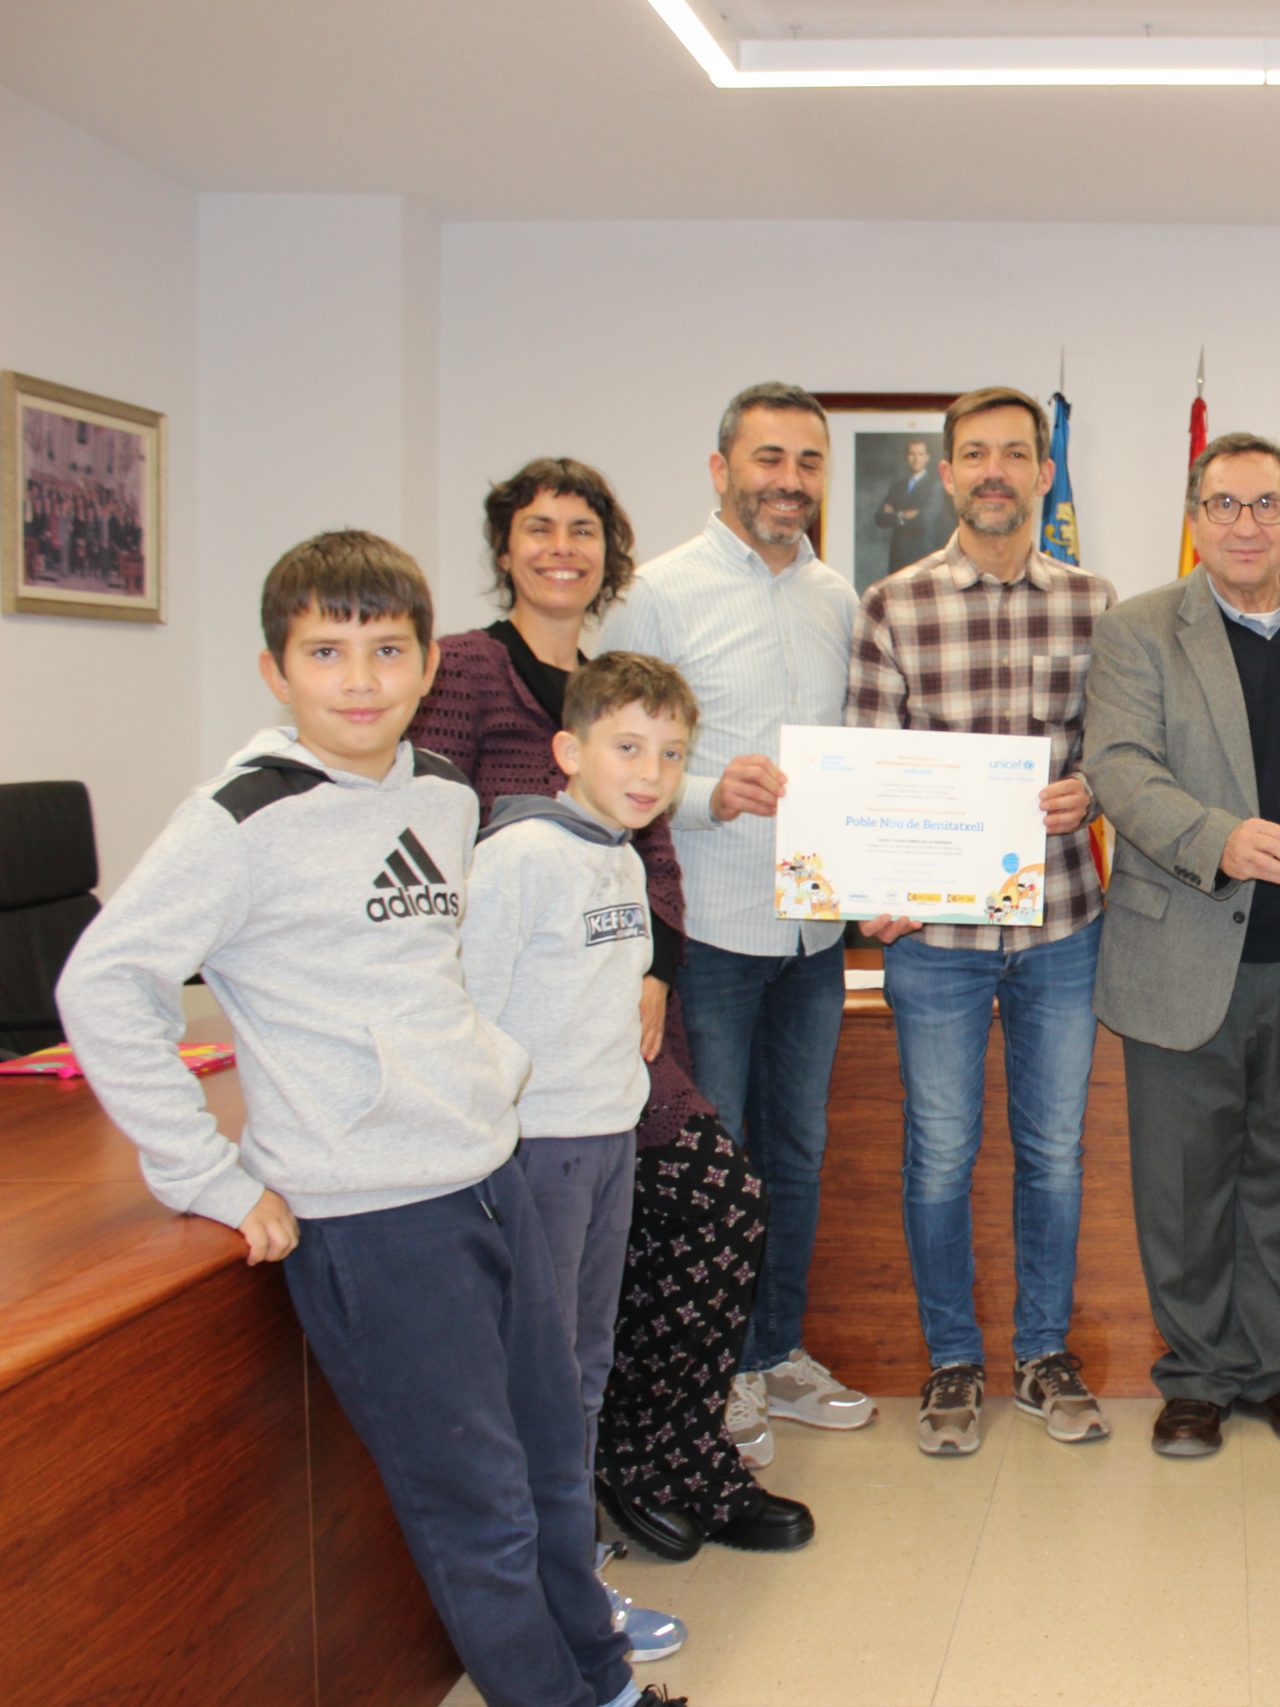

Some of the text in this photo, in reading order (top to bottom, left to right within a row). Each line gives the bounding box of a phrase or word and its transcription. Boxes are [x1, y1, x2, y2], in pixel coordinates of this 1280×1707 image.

[989, 759, 1021, 769] unicef
[845, 816, 985, 832] Poble Nou de Benitatxell
[366, 885, 459, 922] adidas
